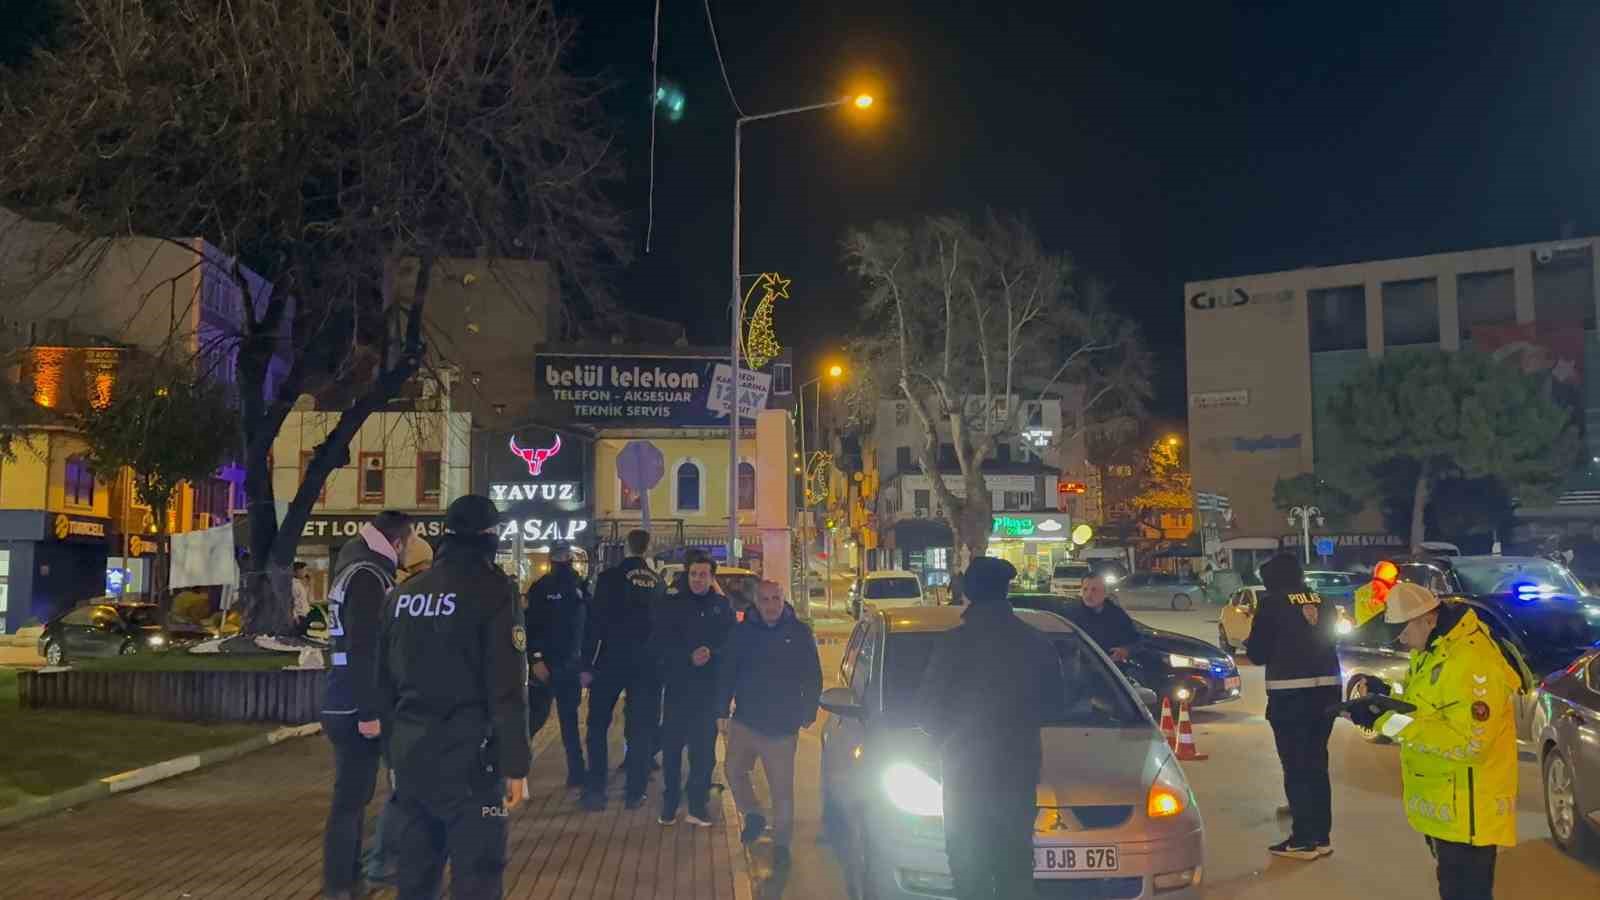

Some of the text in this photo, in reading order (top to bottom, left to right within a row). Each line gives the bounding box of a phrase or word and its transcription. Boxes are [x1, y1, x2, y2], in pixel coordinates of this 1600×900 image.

[545, 364, 699, 389] betül telekom
[552, 389, 610, 400] TELEFON
[623, 391, 692, 403] AKSESUAR
[574, 404, 671, 417] TEKNİK SERVİS
[492, 484, 573, 500] YAVUZ
[1046, 849, 1076, 868] BJB
[1086, 849, 1115, 868] 676
